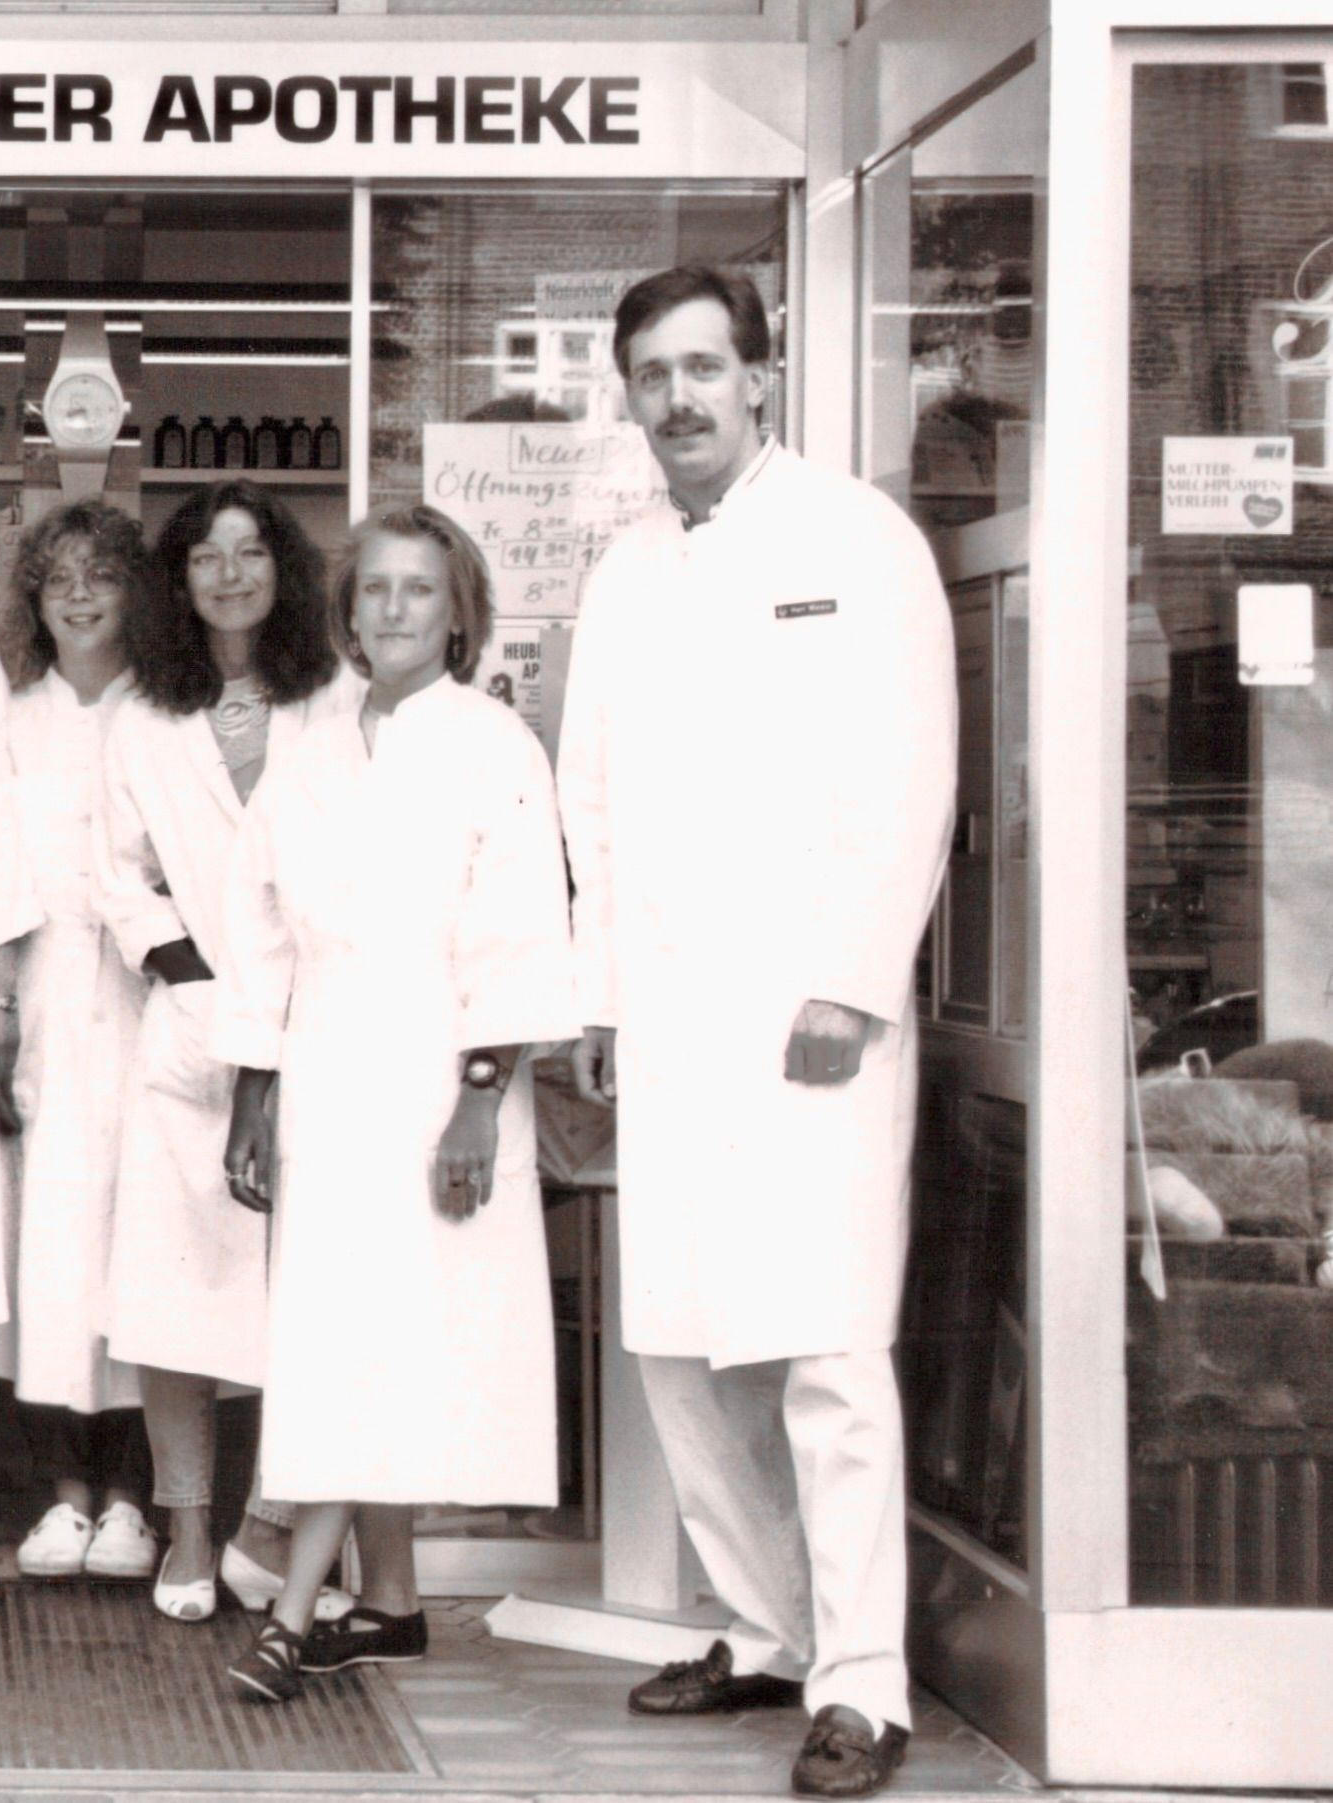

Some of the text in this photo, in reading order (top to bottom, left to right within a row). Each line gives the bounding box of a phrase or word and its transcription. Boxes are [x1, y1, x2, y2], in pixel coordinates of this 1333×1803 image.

[144, 75, 638, 143] APOTHEKE
[518, 434, 595, 466] Neue
[1167, 495, 1228, 508] VERLEIH
